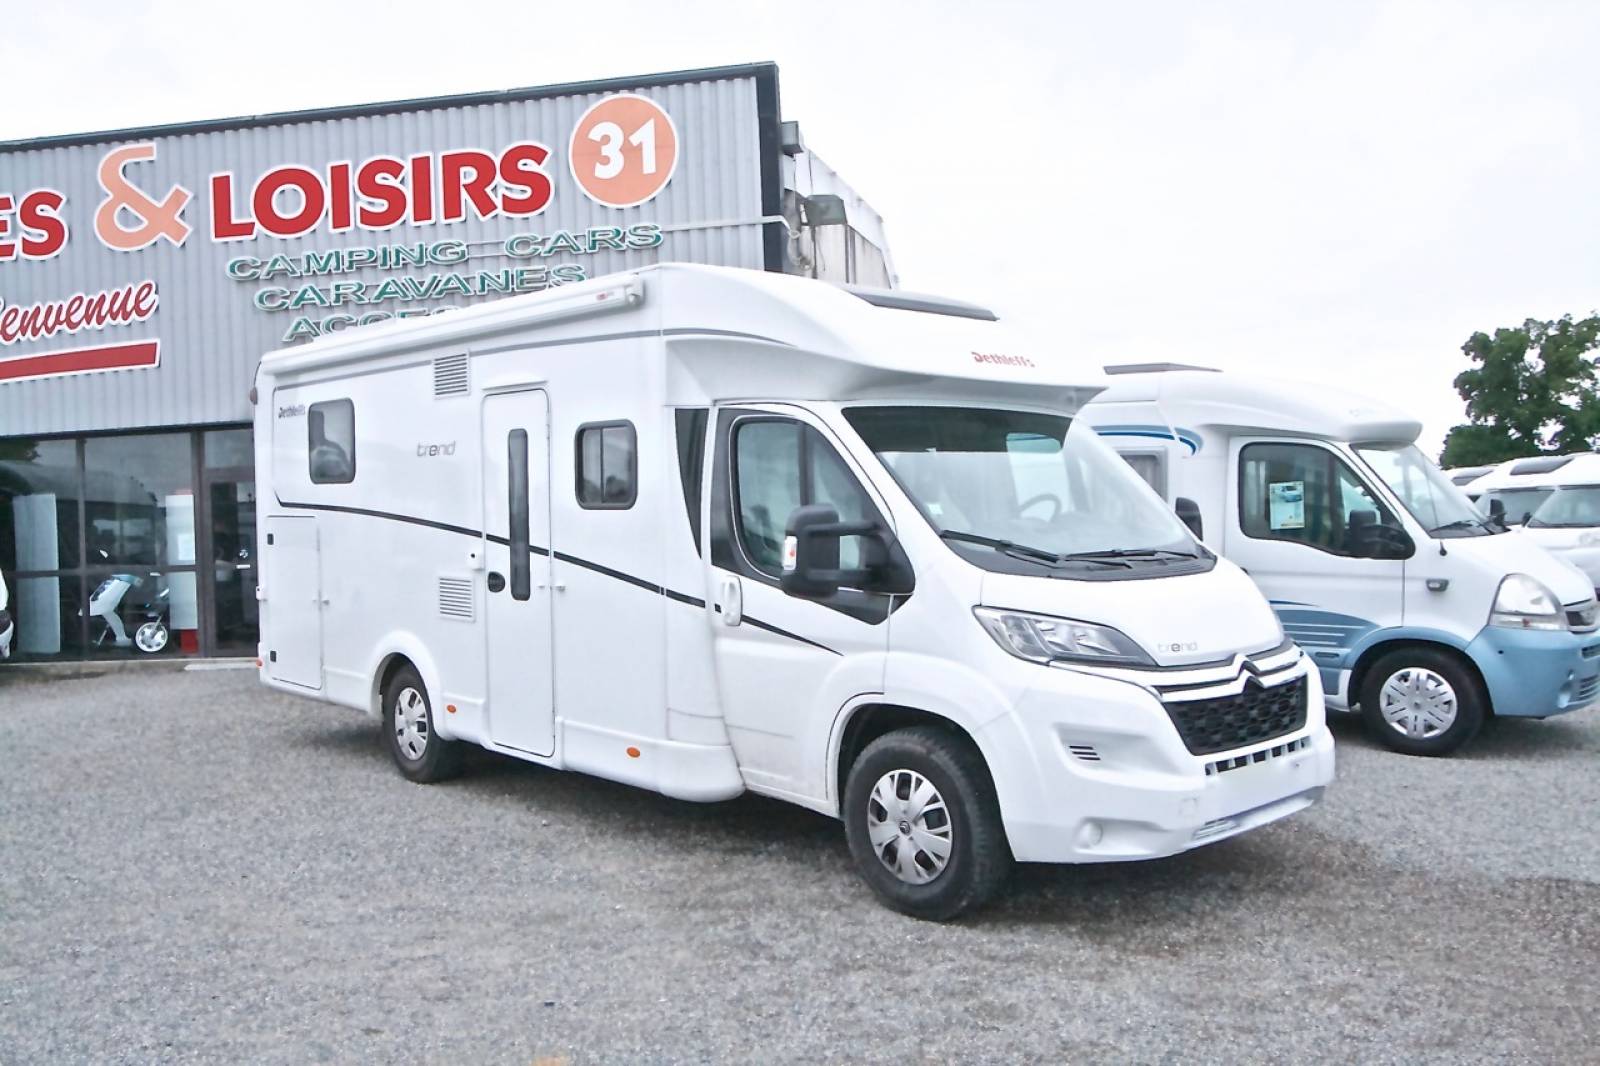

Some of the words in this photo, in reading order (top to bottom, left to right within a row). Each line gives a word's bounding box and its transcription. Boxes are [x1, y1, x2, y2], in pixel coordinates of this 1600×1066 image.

[95, 144, 192, 250] &
[210, 142, 553, 240] LOISIRS
[588, 118, 656, 180] 31
[227, 241, 467, 281] CAMPING
[505, 224, 663, 258] CARS
[255, 265, 585, 311] CARAVANES
[416, 440, 456, 457] trend
